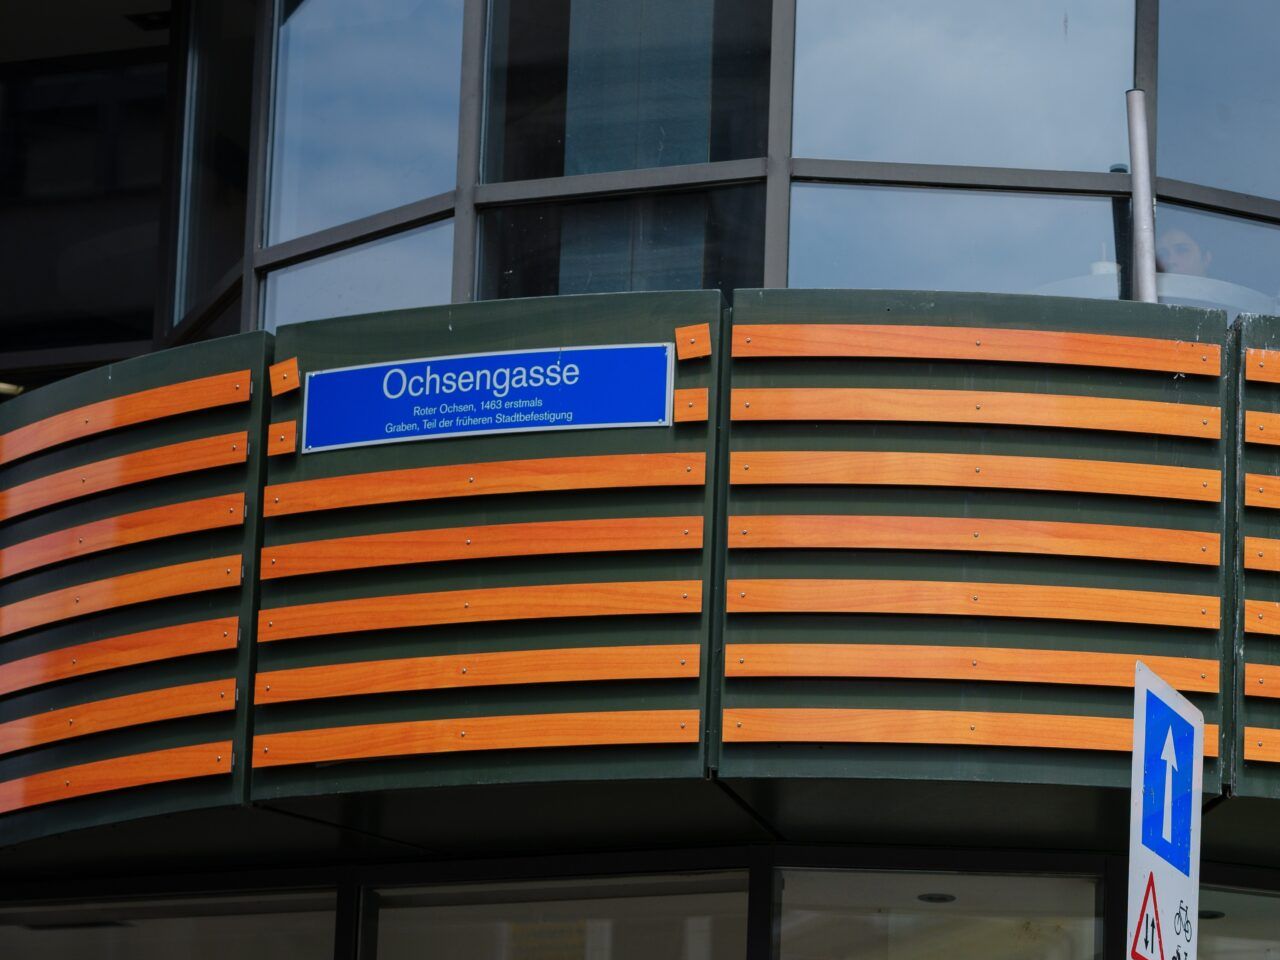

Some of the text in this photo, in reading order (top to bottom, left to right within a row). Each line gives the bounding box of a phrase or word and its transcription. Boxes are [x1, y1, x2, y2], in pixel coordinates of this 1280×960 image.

[383, 363, 580, 398] Ochsengasse
[413, 397, 543, 417] Roter Ochsen, 1463 erstmals
[385, 410, 574, 434] Graben, Teil der früheren Stadtbefestigung
